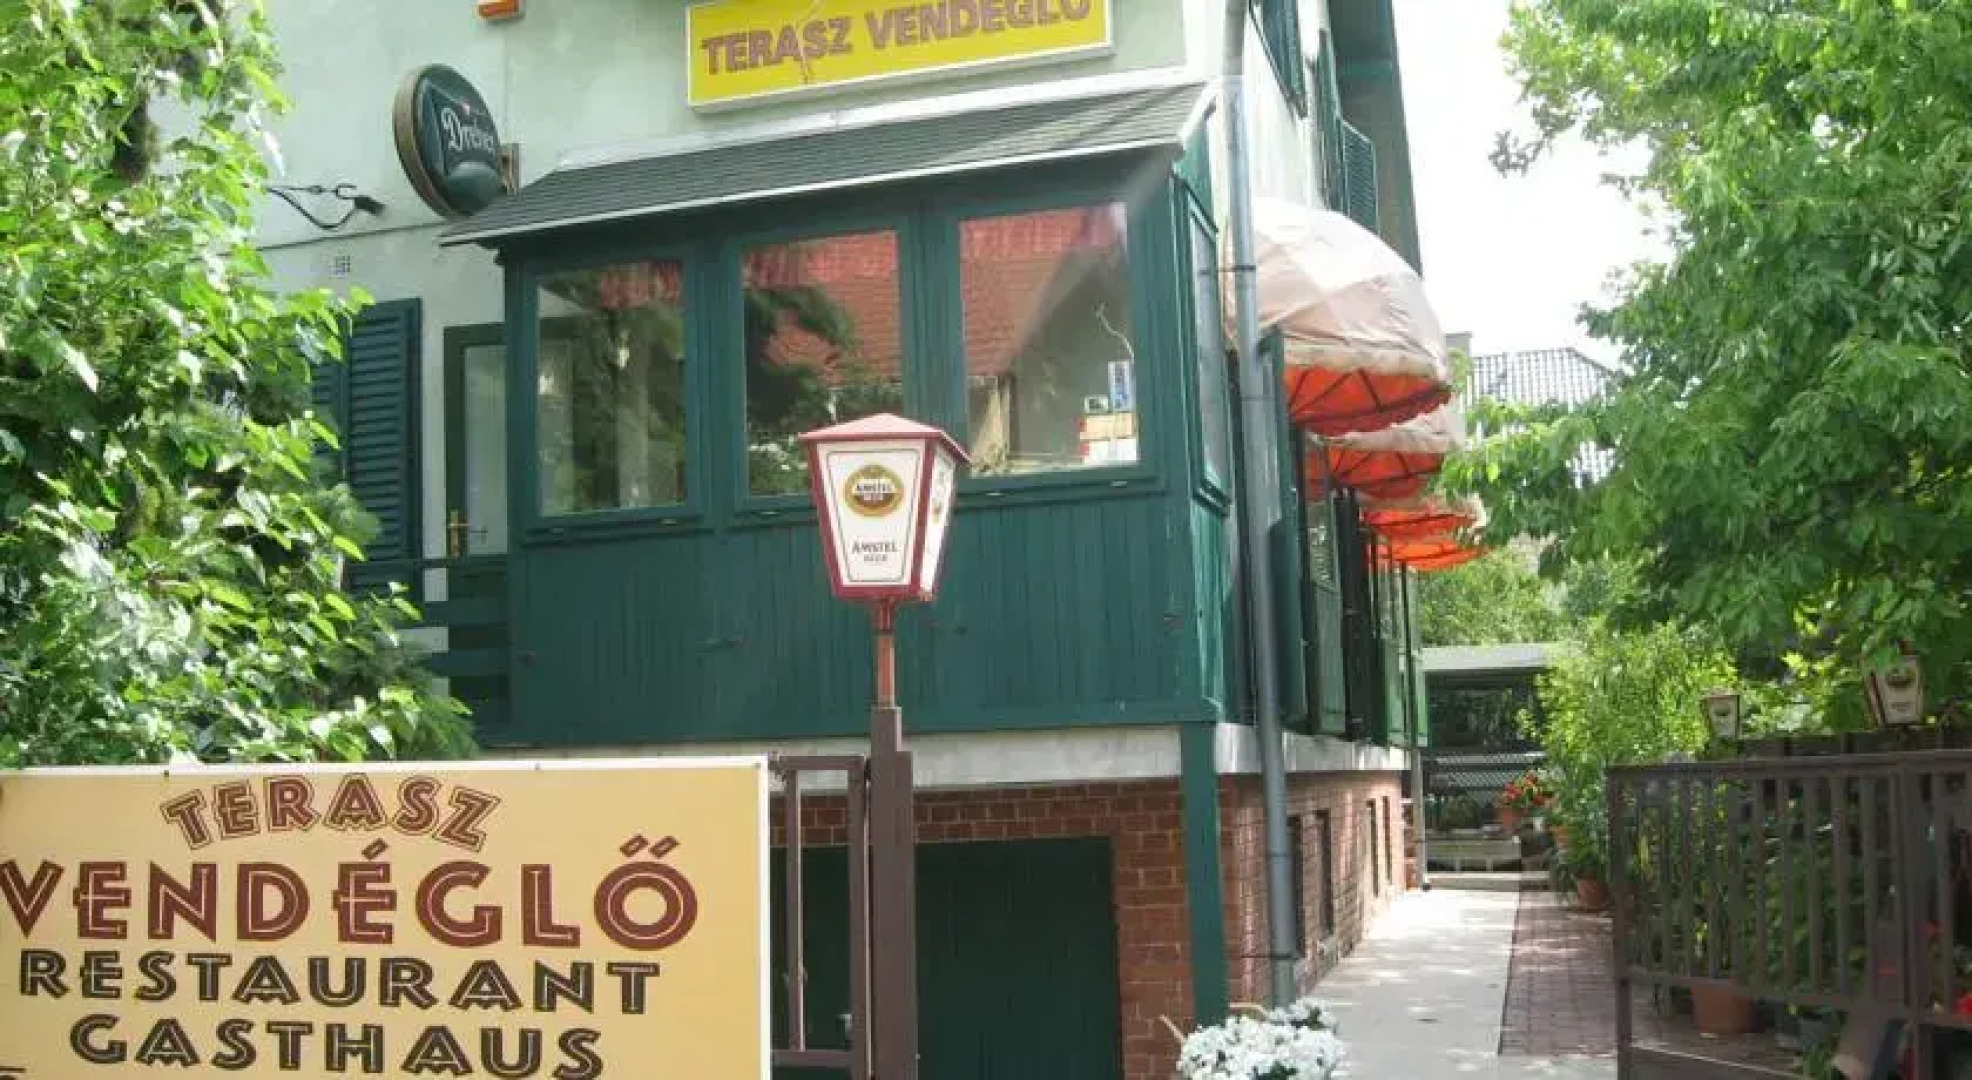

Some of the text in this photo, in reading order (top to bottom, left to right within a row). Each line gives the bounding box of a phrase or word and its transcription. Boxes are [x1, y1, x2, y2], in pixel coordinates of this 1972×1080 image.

[701, 16, 852, 75] TERASZ
[851, 541, 898, 554] AMSTEL
[160, 773, 501, 852] TERASZ
[0, 834, 698, 952] VENDÉGLŐ
[20, 949, 660, 1015] RESTAURANT
[70, 1013, 604, 1080] GASTHAUS
